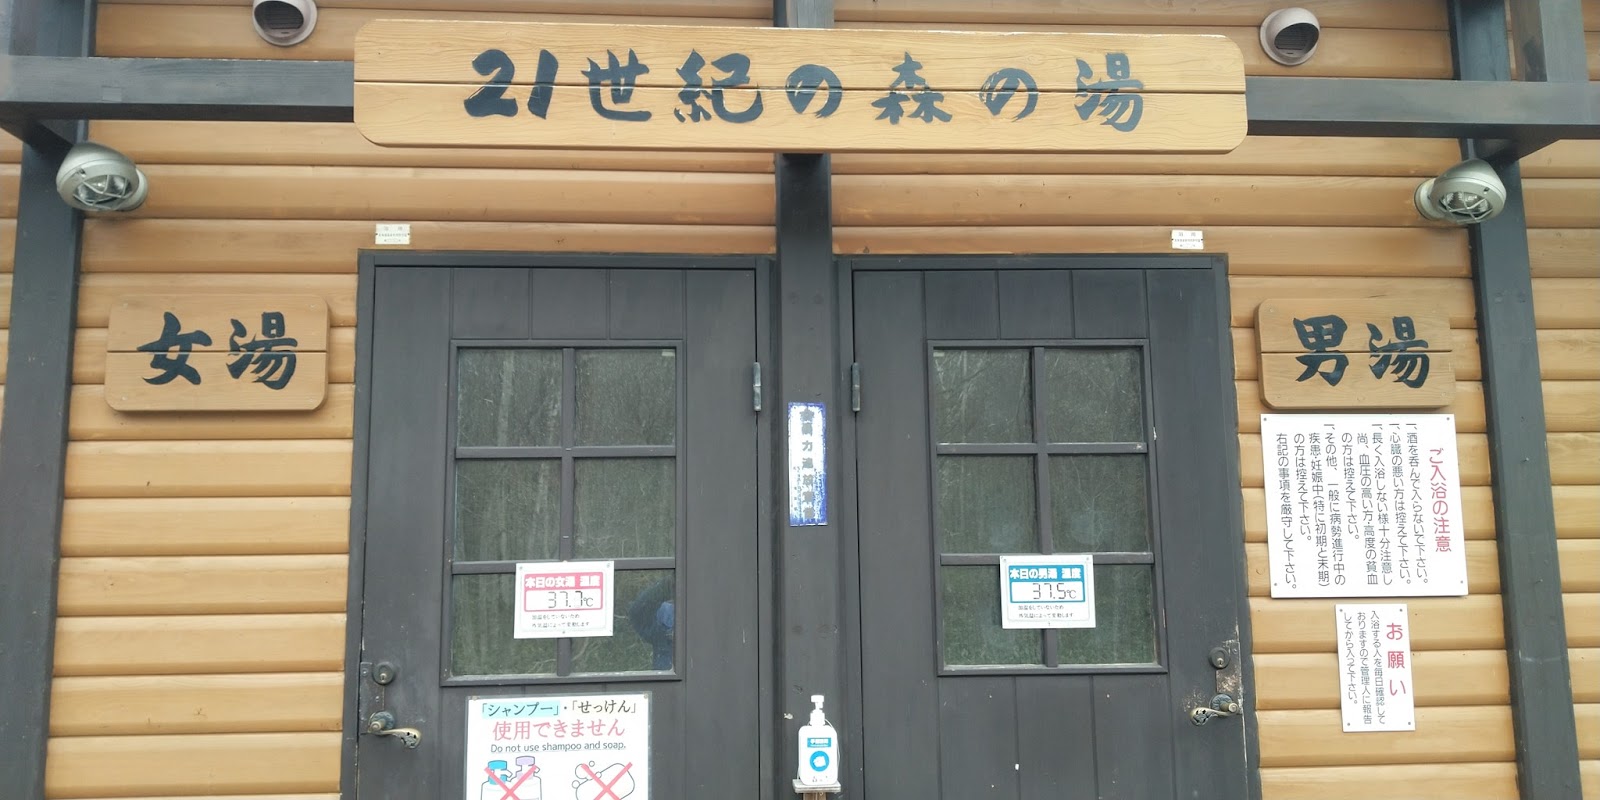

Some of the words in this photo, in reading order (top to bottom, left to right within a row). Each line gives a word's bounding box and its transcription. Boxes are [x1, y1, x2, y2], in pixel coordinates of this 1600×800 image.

[463, 48, 1145, 132] 21世紀の森の湯
[136, 311, 298, 390] 女湯
[1293, 315, 1430, 389] 男湯
[1276, 432, 1297, 589] 右記の事項を厳守して下さい。
[1293, 432, 1312, 541] の方は控えて下さい。
[1341, 432, 1360, 540] の方は控えて下さい。
[1428, 447, 1452, 553] ご入浴の注意
[1009, 567, 1058, 580] 本日の男湯
[1343, 612, 1358, 705] してから入って下さい。
[1357, 611, 1373, 725] おりますので管理人に報告
[1386, 622, 1407, 697] お願い
[490, 744, 504, 753] Do
[505, 743, 521, 753] not
[523, 743, 540, 752] use
[541, 742, 582, 752] shampoo
[584, 741, 601, 750] and
[602, 741, 627, 751] soap.
[492, 718, 626, 741] 使用できません
